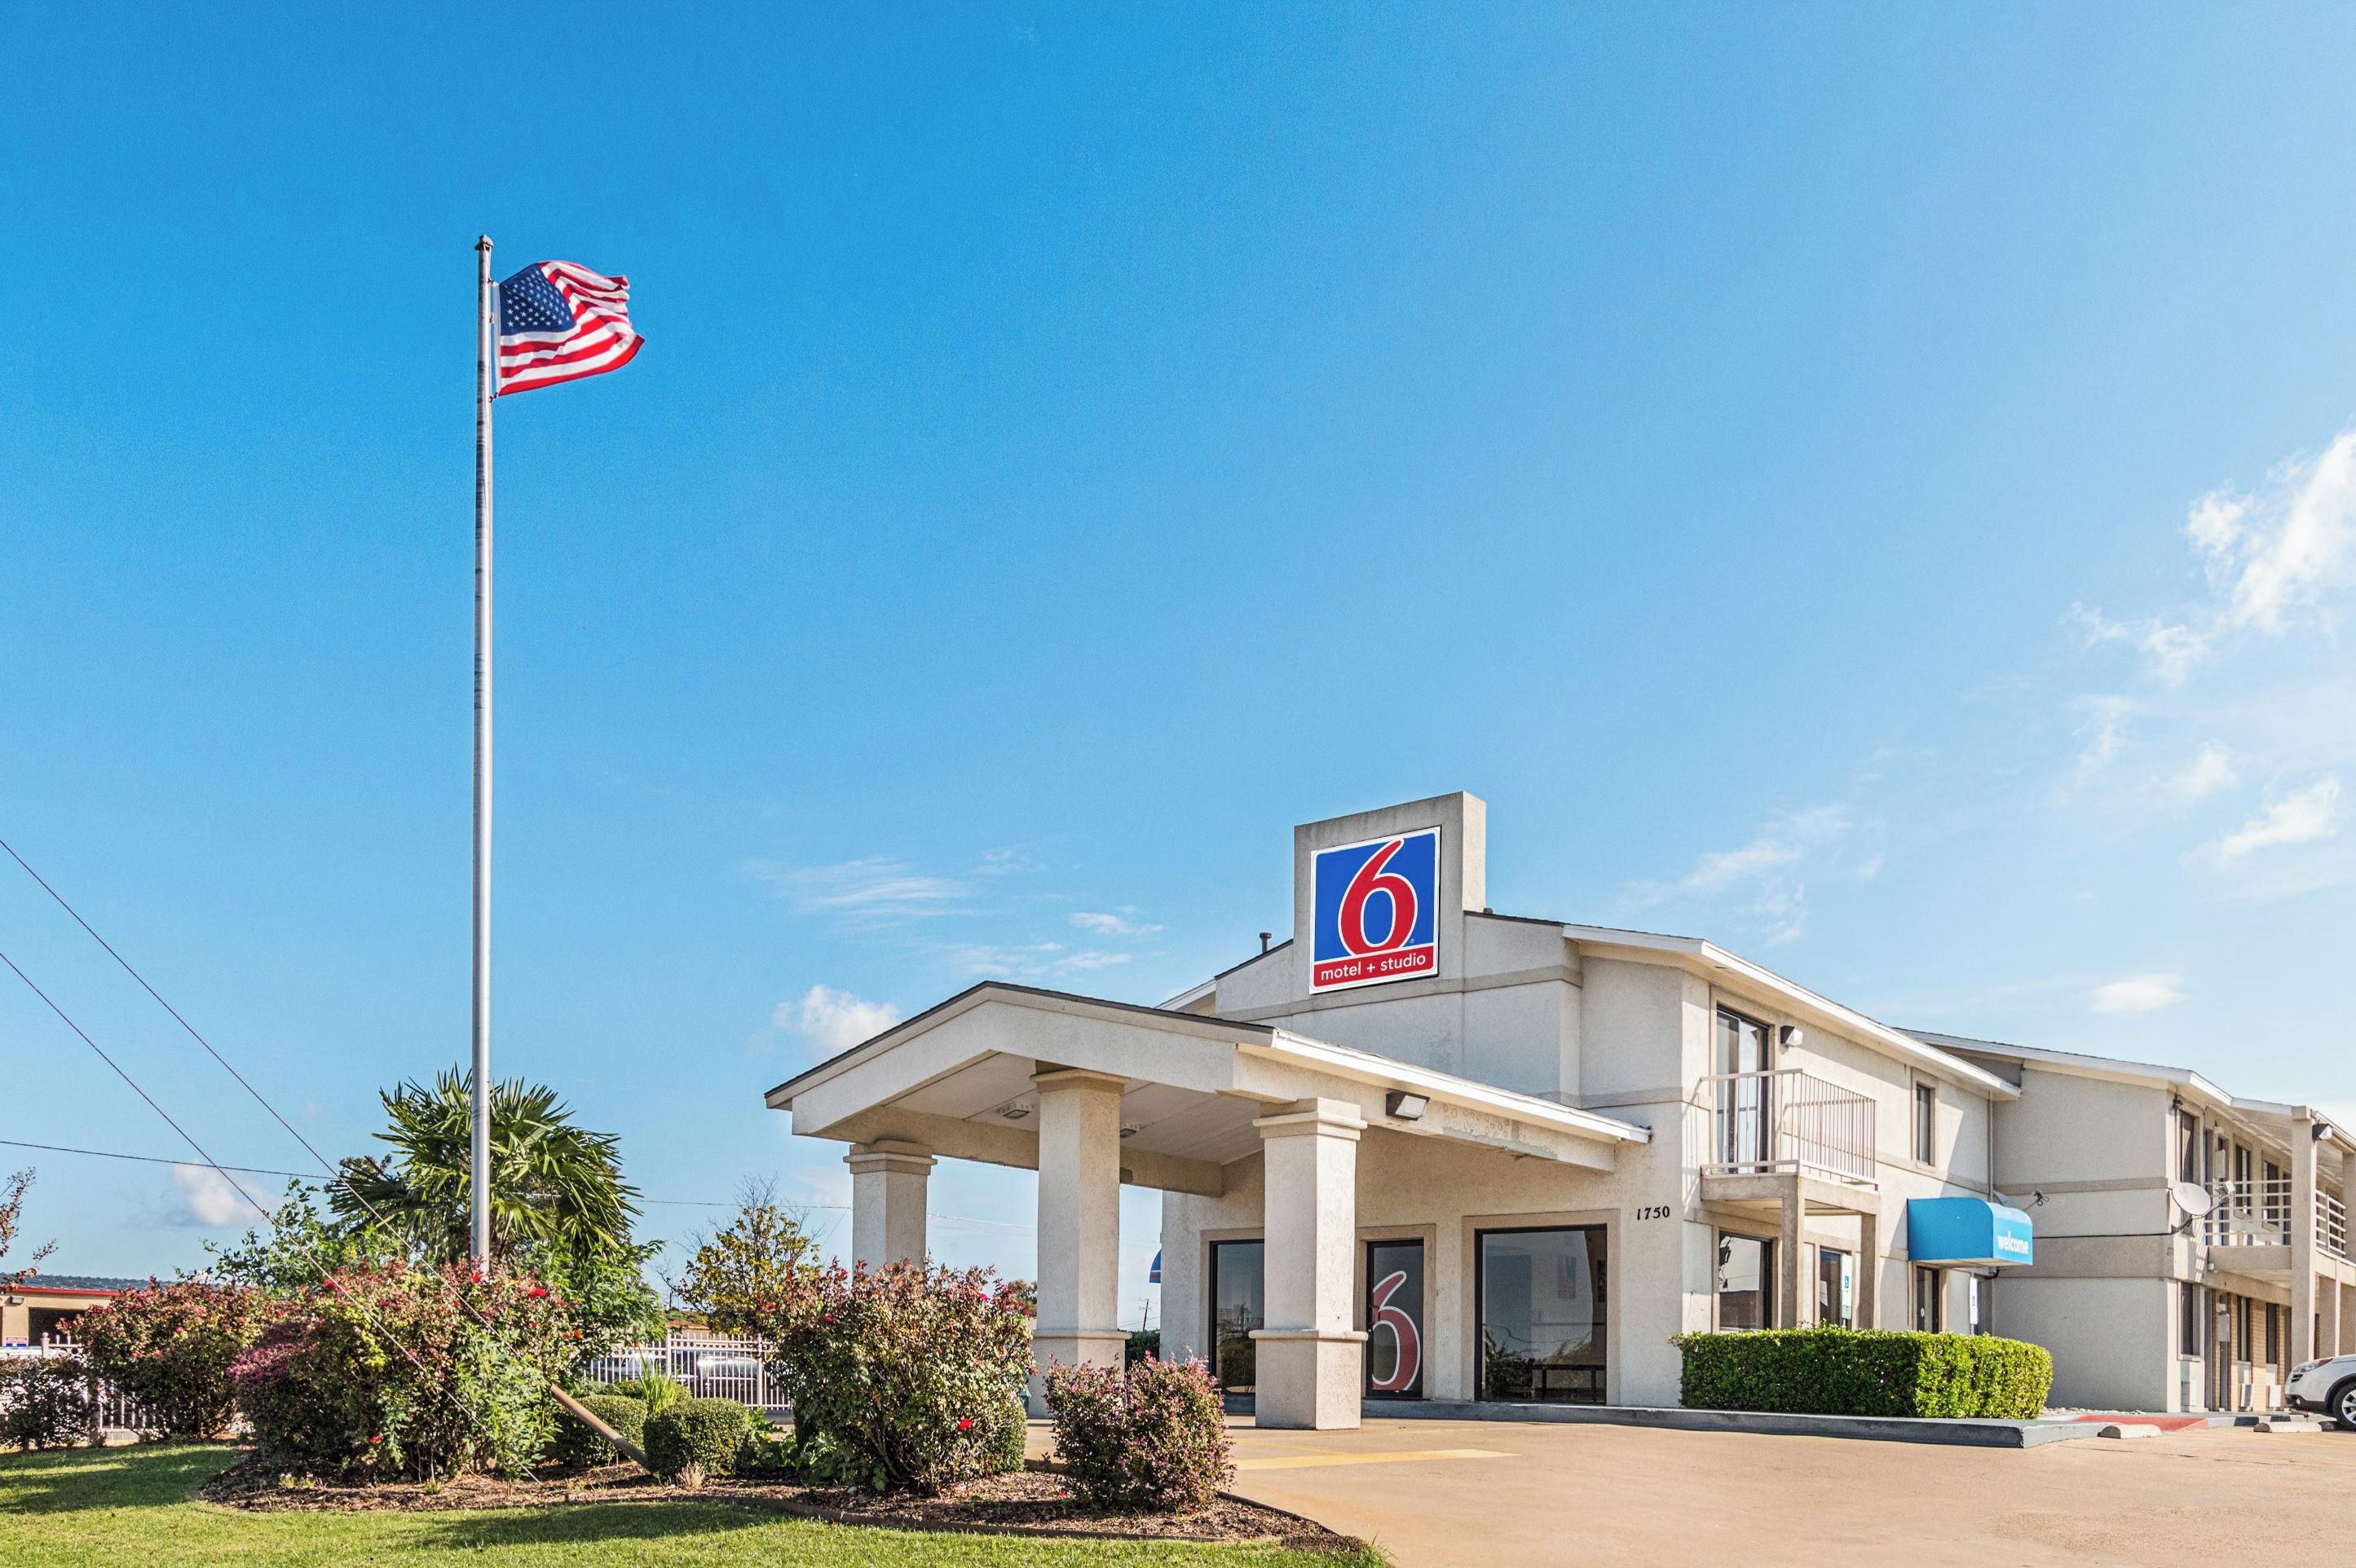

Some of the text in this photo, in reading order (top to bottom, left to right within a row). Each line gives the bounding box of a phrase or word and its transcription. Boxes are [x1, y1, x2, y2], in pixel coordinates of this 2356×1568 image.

[1339, 839, 1418, 957] 6
[1321, 962, 1361, 980] motel
[1380, 953, 1426, 971] studio
[1637, 1206, 1670, 1221] 1750
[1997, 1231, 2029, 1255] welcome
